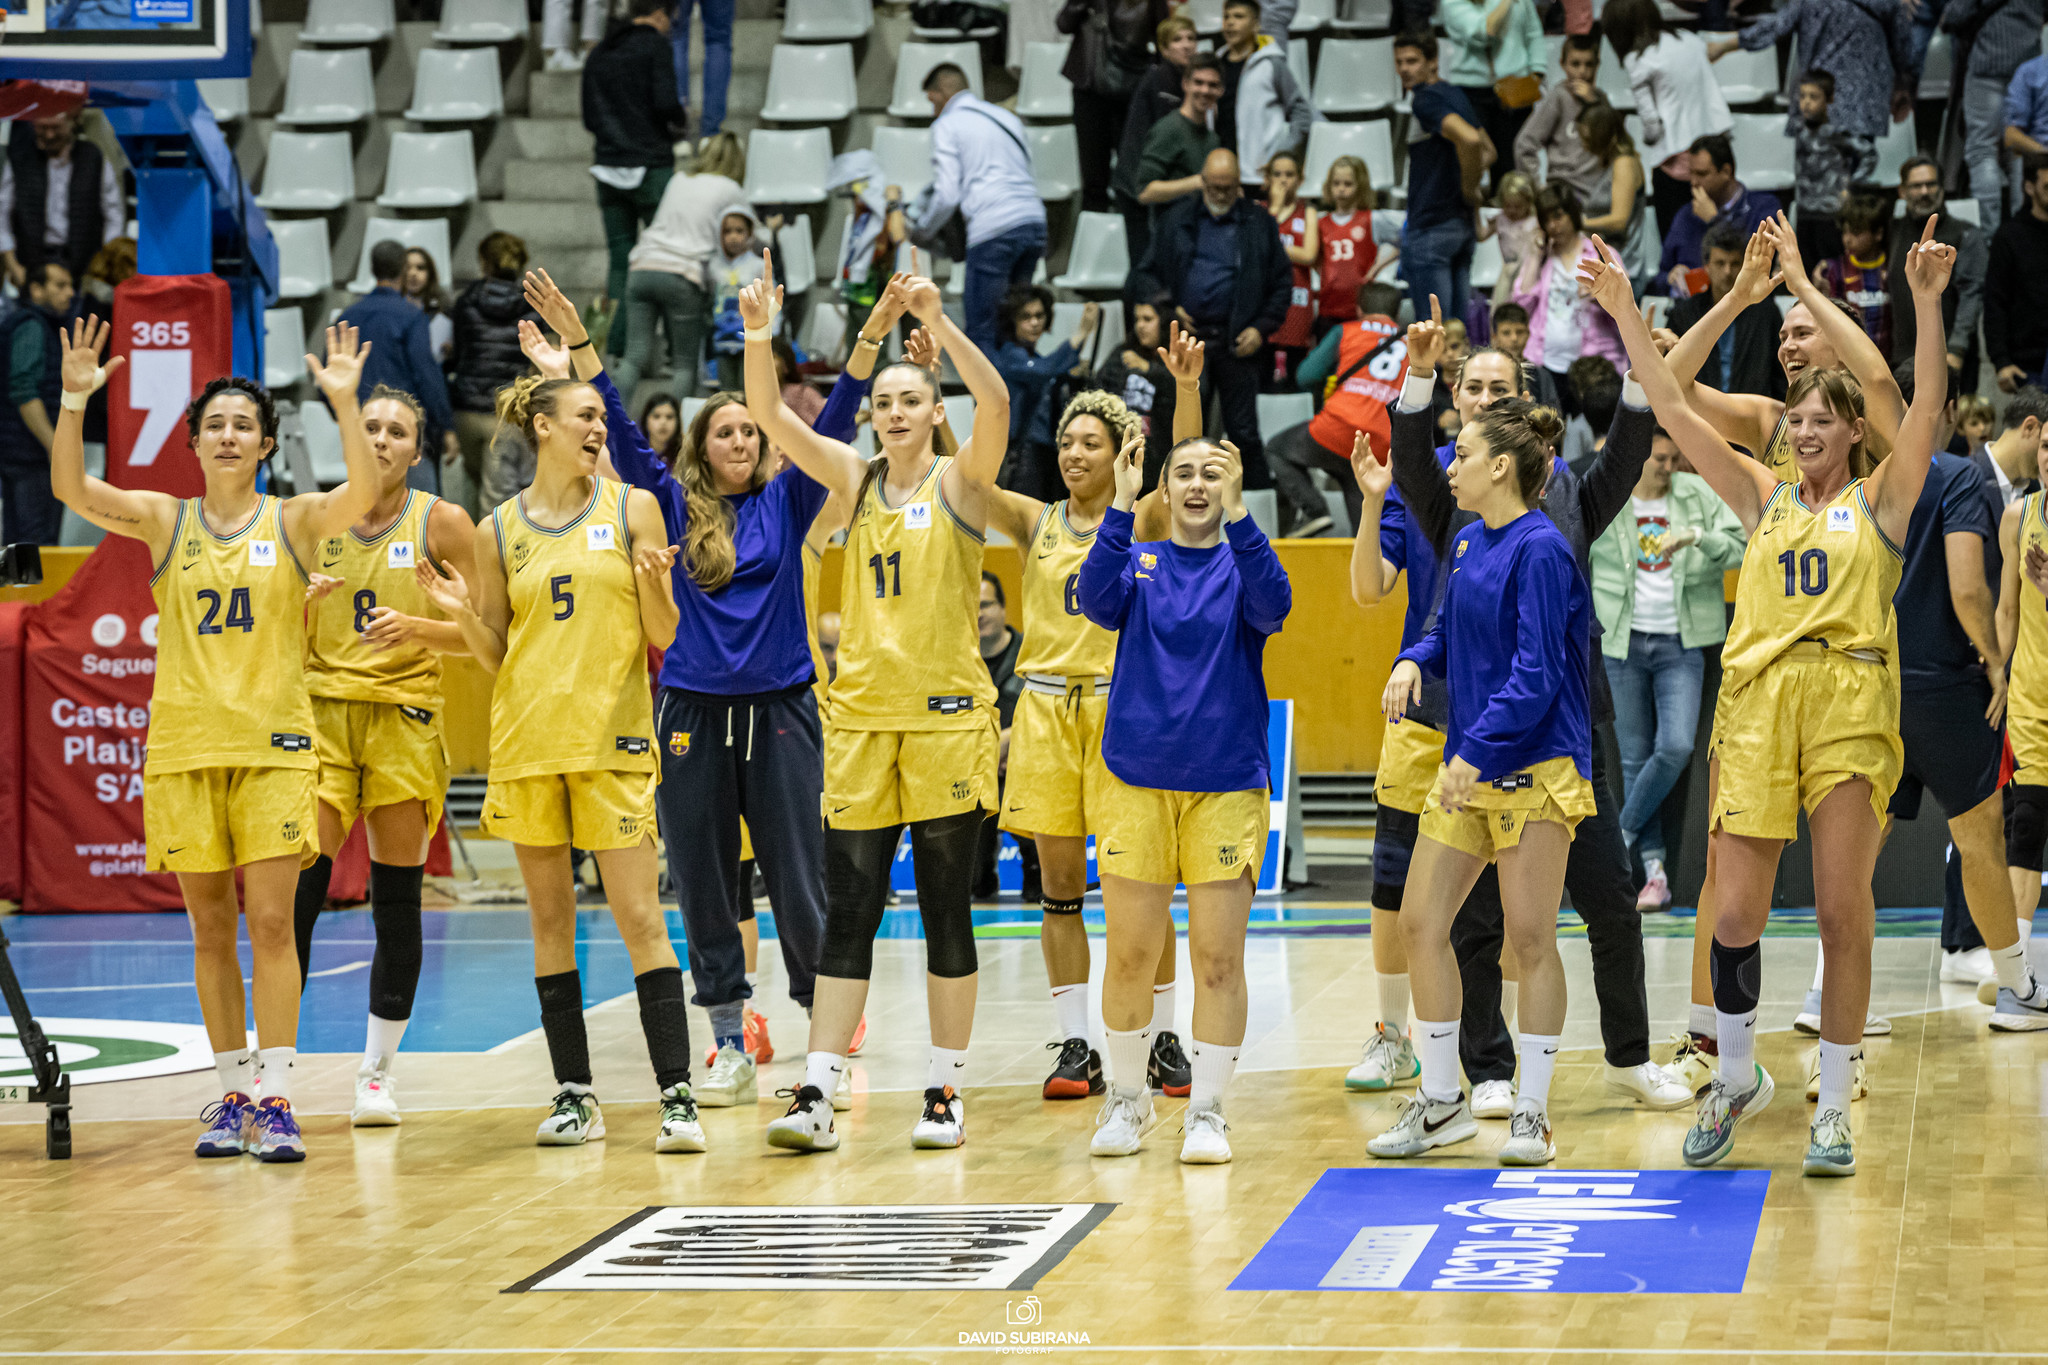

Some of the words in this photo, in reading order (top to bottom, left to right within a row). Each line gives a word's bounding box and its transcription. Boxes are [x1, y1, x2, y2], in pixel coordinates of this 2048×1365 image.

[1330, 239, 1355, 261] 33
[131, 321, 191, 346] 365
[869, 551, 901, 599] 11
[1778, 548, 1829, 597] 10
[197, 586, 254, 635] 24
[353, 588, 377, 633] 8
[551, 574, 575, 621] 5
